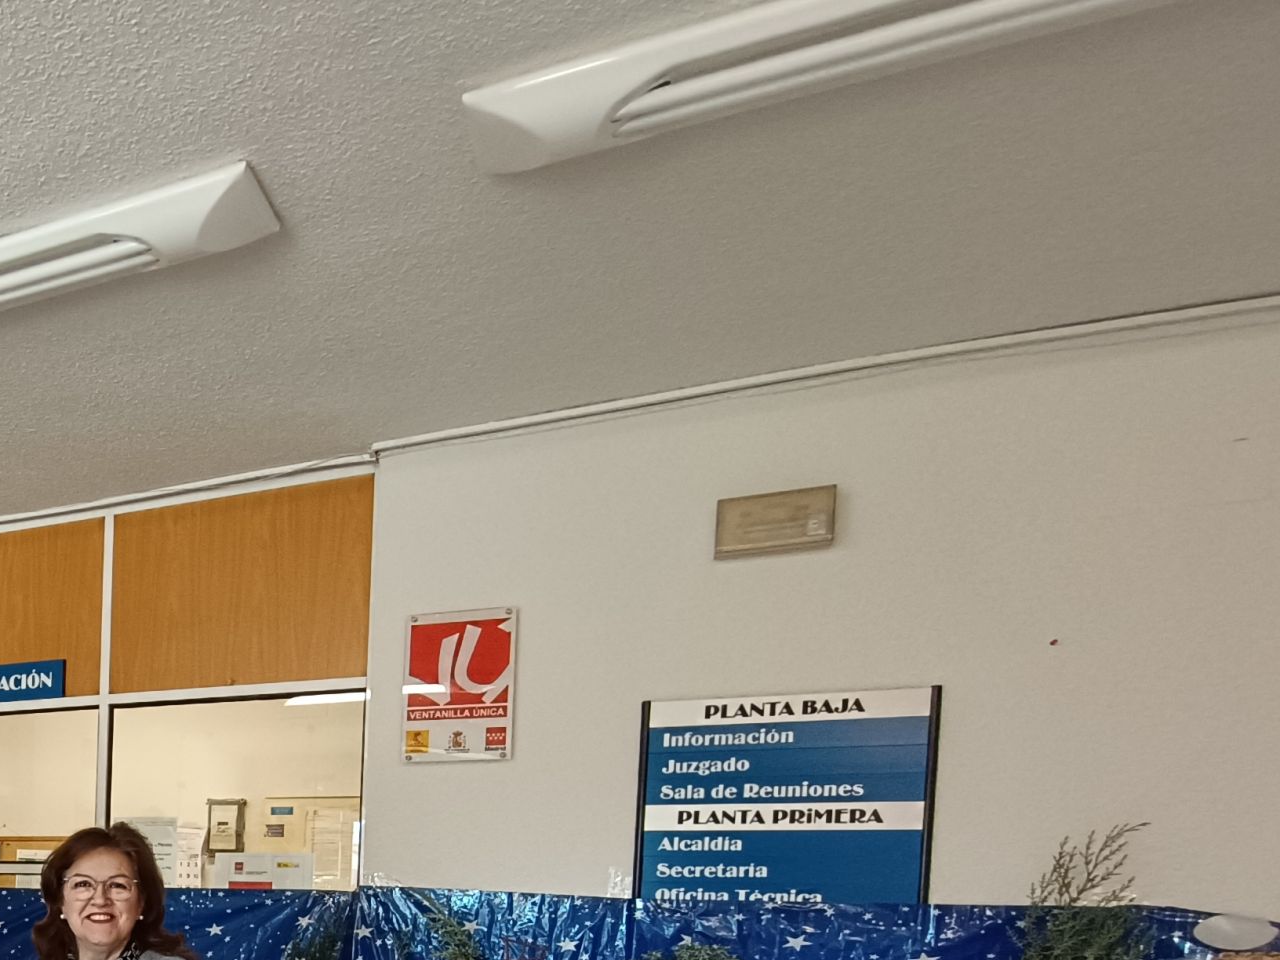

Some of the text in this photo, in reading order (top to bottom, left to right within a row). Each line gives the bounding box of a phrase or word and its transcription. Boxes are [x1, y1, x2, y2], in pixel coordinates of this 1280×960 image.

[409, 706, 505, 720] VENTANILLA ÚNICA
[704, 697, 866, 720] PLANTA BAJA
[663, 728, 795, 748] Información
[661, 757, 750, 776] Juzgado
[659, 781, 865, 800] Sala de Reuniones
[676, 809, 766, 825] PLANTA
[654, 888, 823, 903] Oficina Técnica
